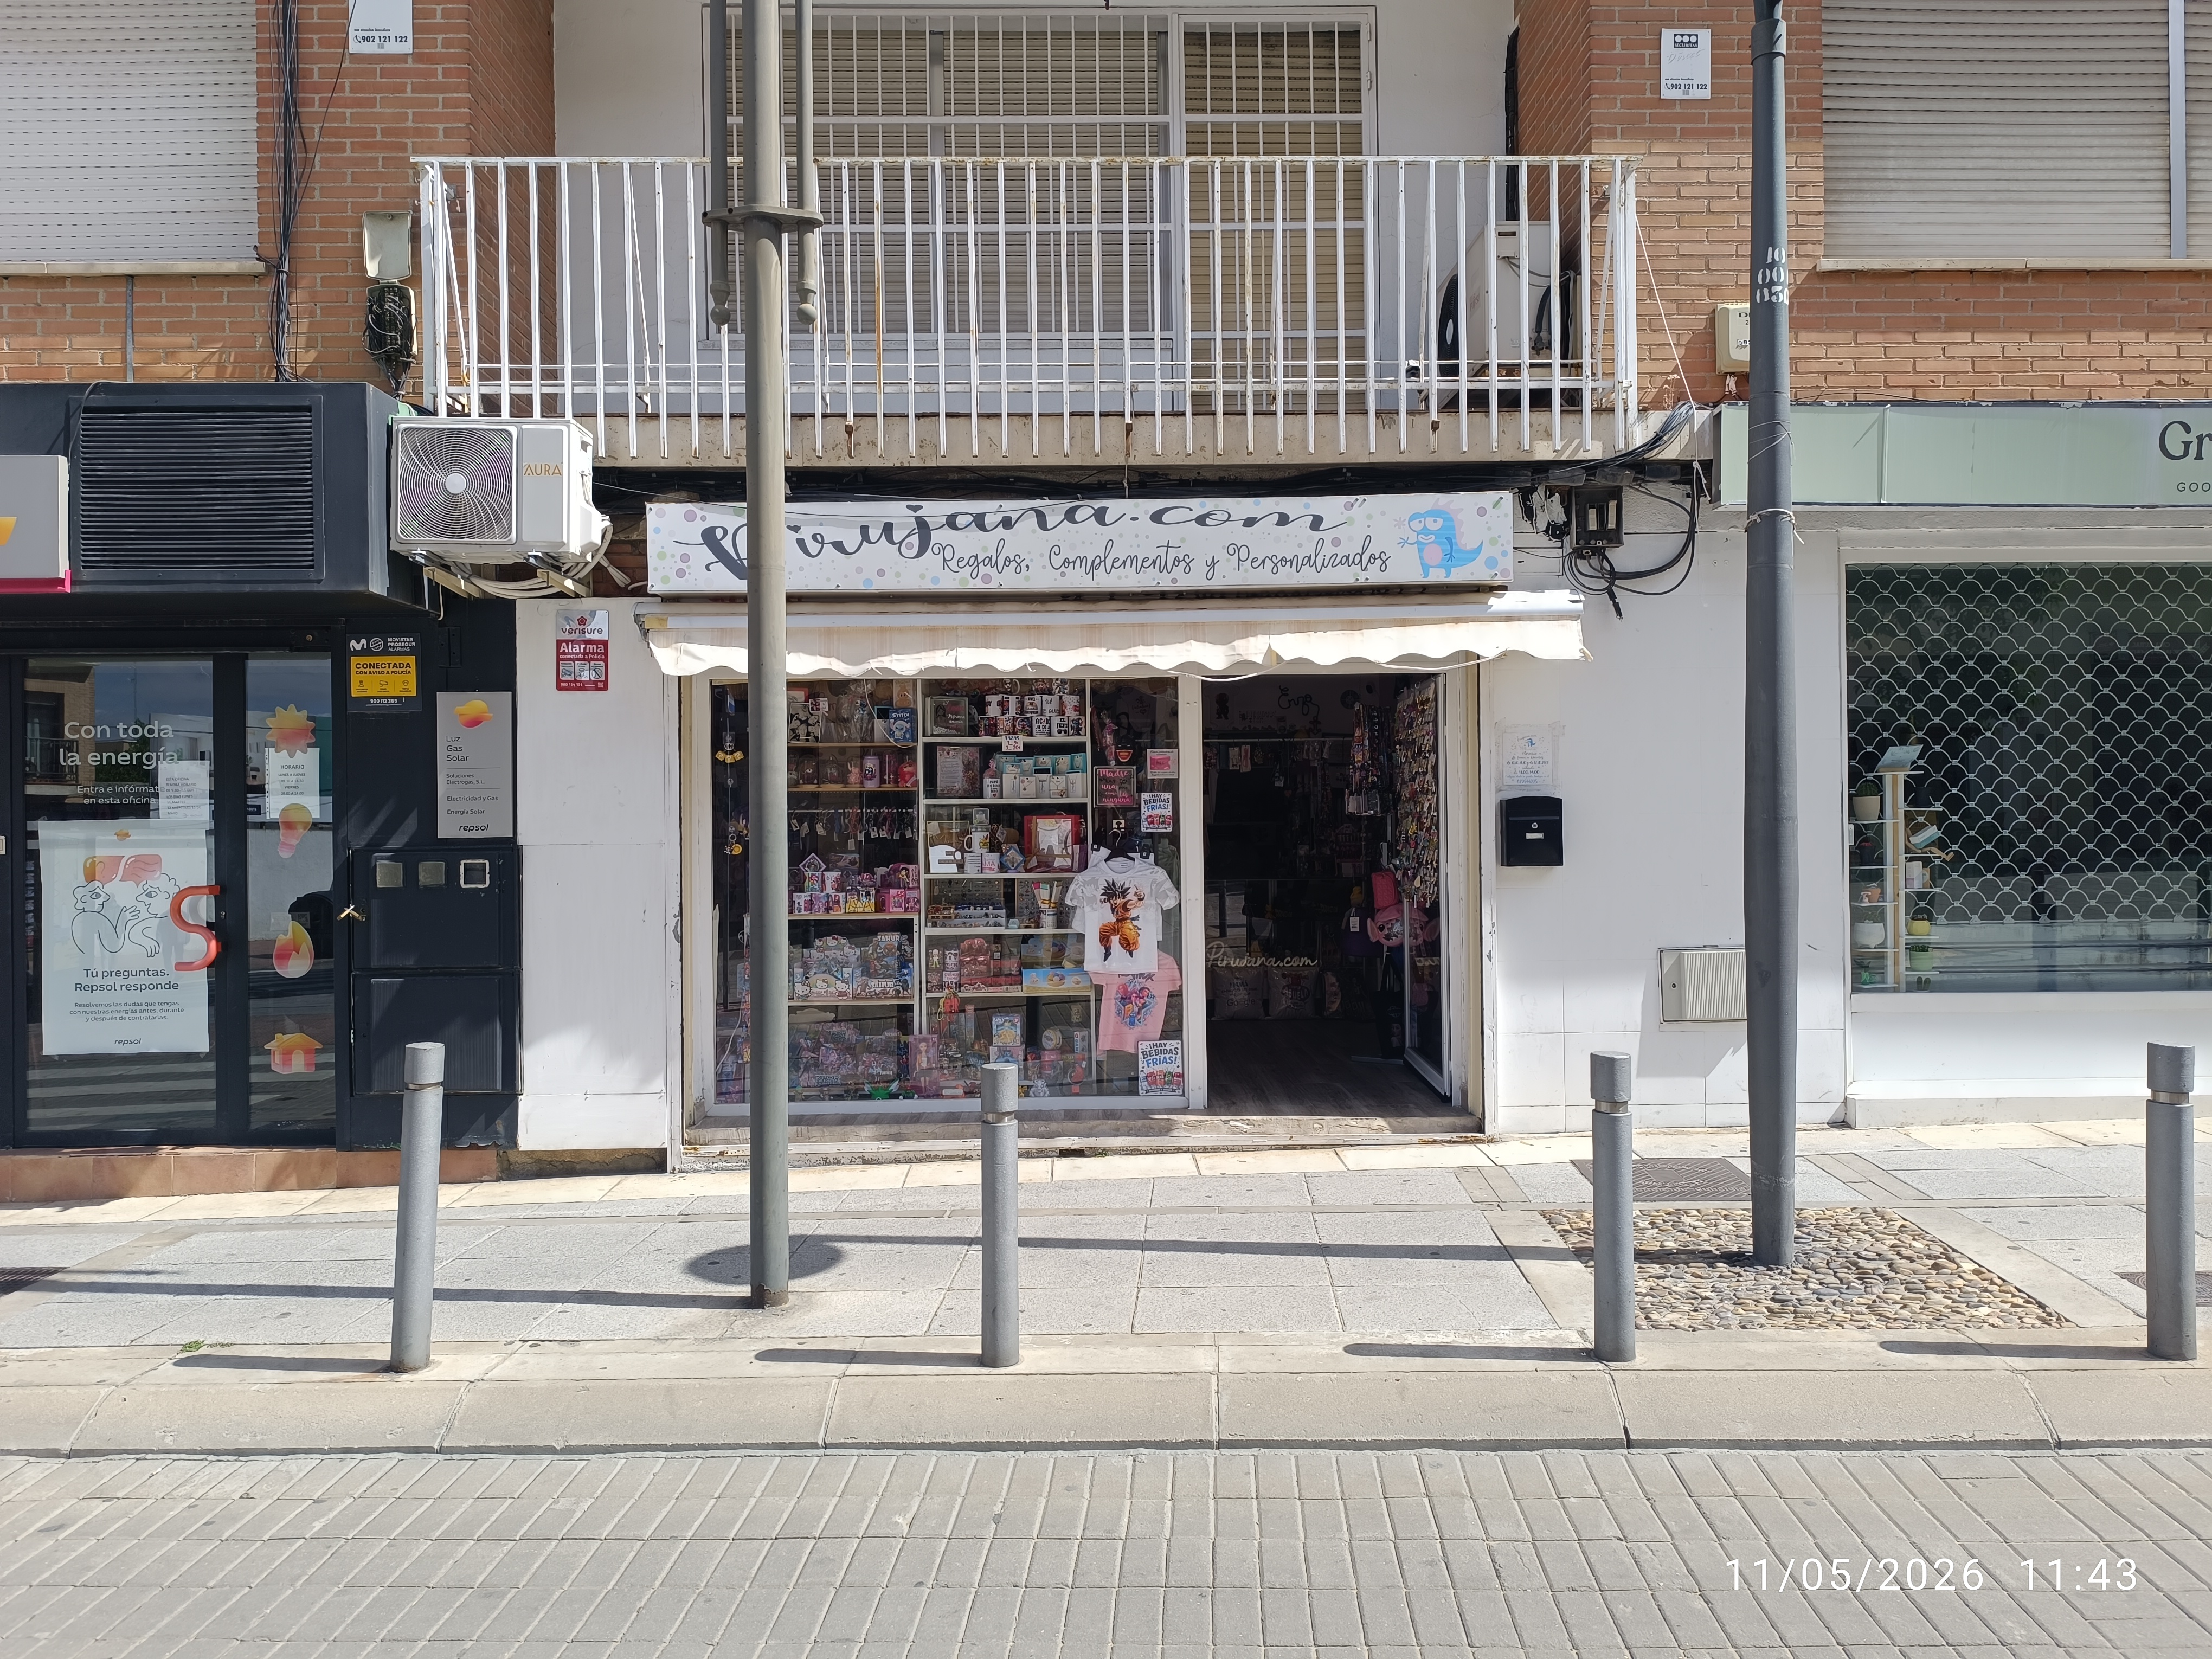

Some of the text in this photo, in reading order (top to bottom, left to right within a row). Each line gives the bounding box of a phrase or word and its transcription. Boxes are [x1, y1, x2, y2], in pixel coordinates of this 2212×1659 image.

[2159, 420, 2212, 460] Gr
[524, 464, 562, 476] AURA
[2177, 481, 2211, 492] GOO
[931, 535, 1392, 581] Regalos, Complementos y Personalizados
[560, 641, 605, 653] Alarma
[64, 721, 174, 738] Con toda
[60, 747, 179, 769] la energía
[115, 785, 165, 793] infórmate
[123, 796, 158, 804] oficina.
[1143, 797, 1170, 806] BEBIDAS
[1146, 803, 1169, 812] FRÍAS!
[459, 824, 488, 832] repsol
[83, 968, 169, 980] Tú preguntas.
[75, 981, 179, 993] Repsol responde
[1140, 1047, 1179, 1060] BEBIDAS
[1145, 1055, 1178, 1068] FRÍAS!
